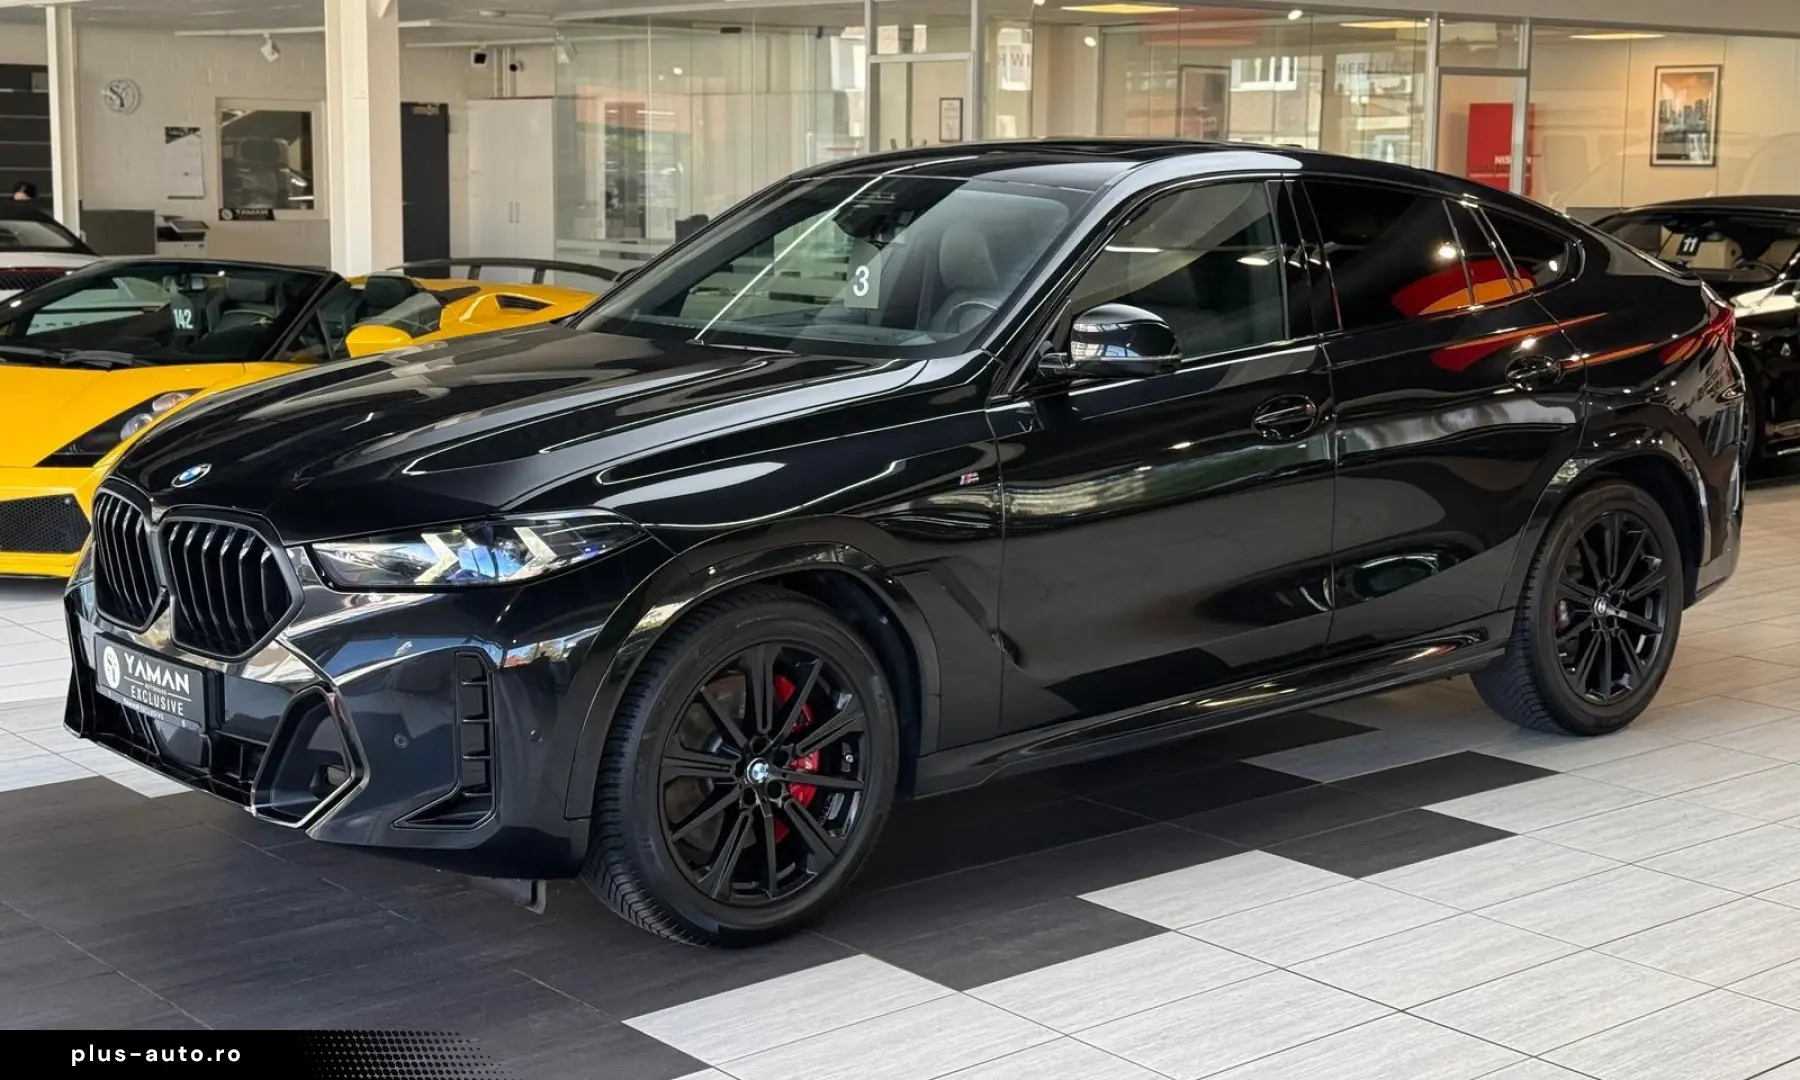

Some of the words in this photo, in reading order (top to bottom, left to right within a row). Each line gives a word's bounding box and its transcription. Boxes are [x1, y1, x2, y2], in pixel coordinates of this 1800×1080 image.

[1494, 154, 1532, 165] NISN
[1682, 236, 1699, 253] 11
[853, 265, 869, 297] 3
[172, 308, 194, 330] 142
[124, 652, 190, 695] YAMAN
[131, 684, 184, 717] EXCLUSIVE
